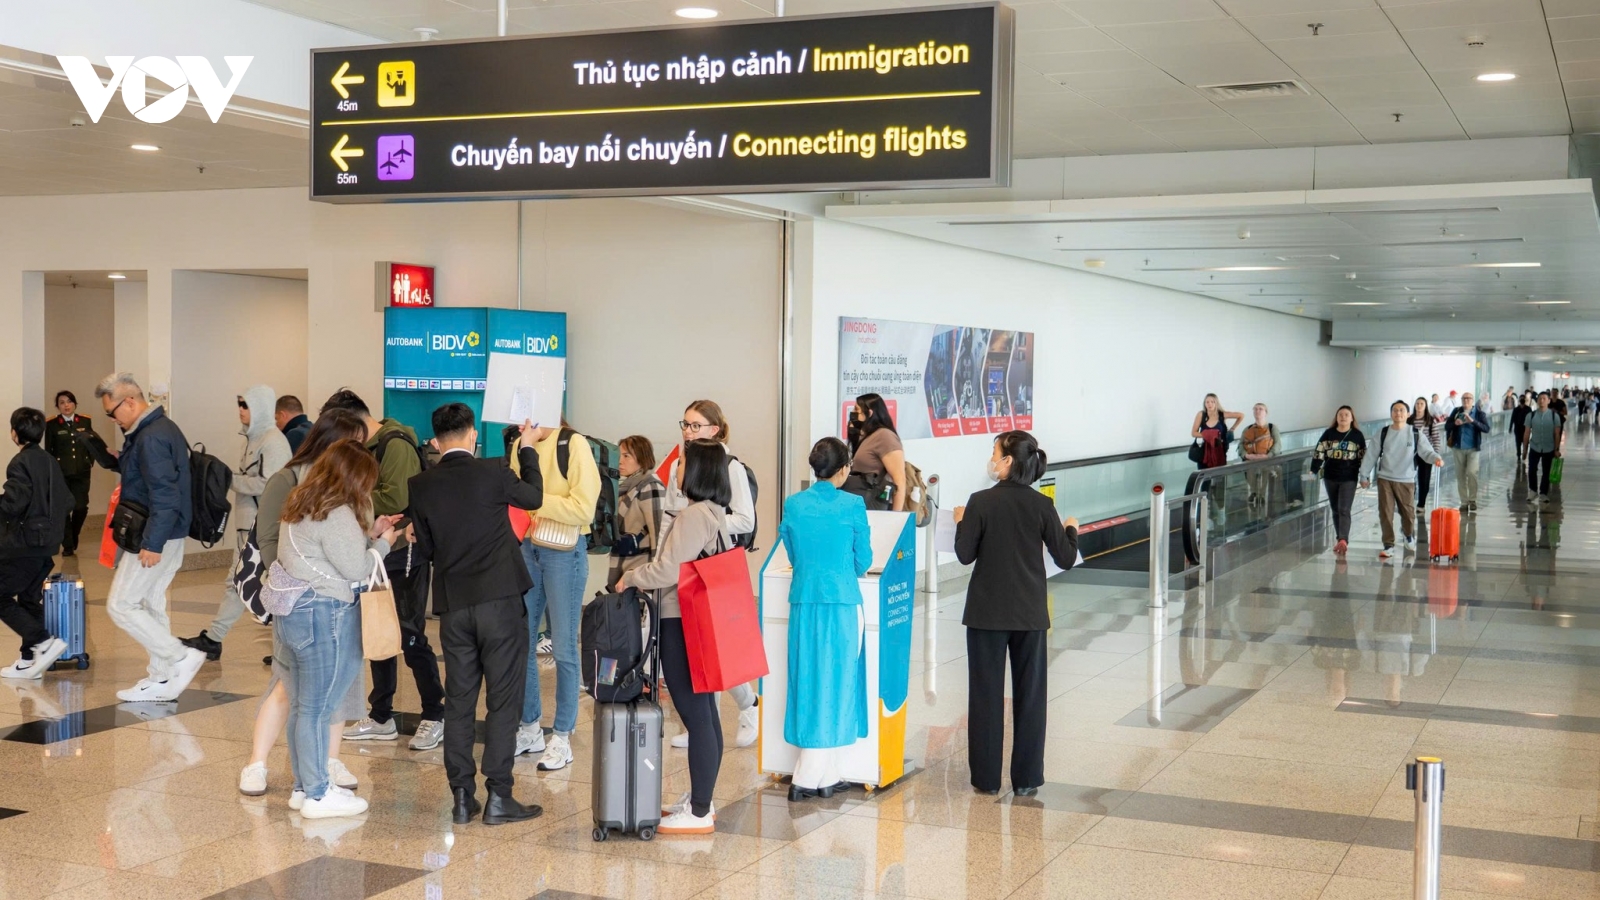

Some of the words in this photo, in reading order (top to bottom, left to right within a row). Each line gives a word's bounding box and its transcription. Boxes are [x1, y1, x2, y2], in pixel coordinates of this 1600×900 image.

[573, 60, 617, 85] Thủ
[622, 60, 660, 88] tục
[666, 55, 726, 85] nhập
[732, 51, 792, 77] cảnh
[797, 48, 808, 73] /
[813, 41, 969, 74] Immigration
[336, 100, 358, 111] 45m
[451, 138, 532, 170] Chuyến
[539, 141, 579, 168] bay
[585, 133, 620, 162] nối
[627, 130, 712, 165] chuyến
[718, 134, 727, 158] /
[733, 129, 876, 159] Connecting
[883, 125, 967, 157] flights
[337, 173, 358, 184] 55m
[843, 321, 877, 334] JINGDONG
[386, 337, 423, 347] AUTOBANK
[432, 334, 467, 350] BIDV
[494, 338, 521, 349] AUTOBANK
[526, 337, 550, 353] BIDV
